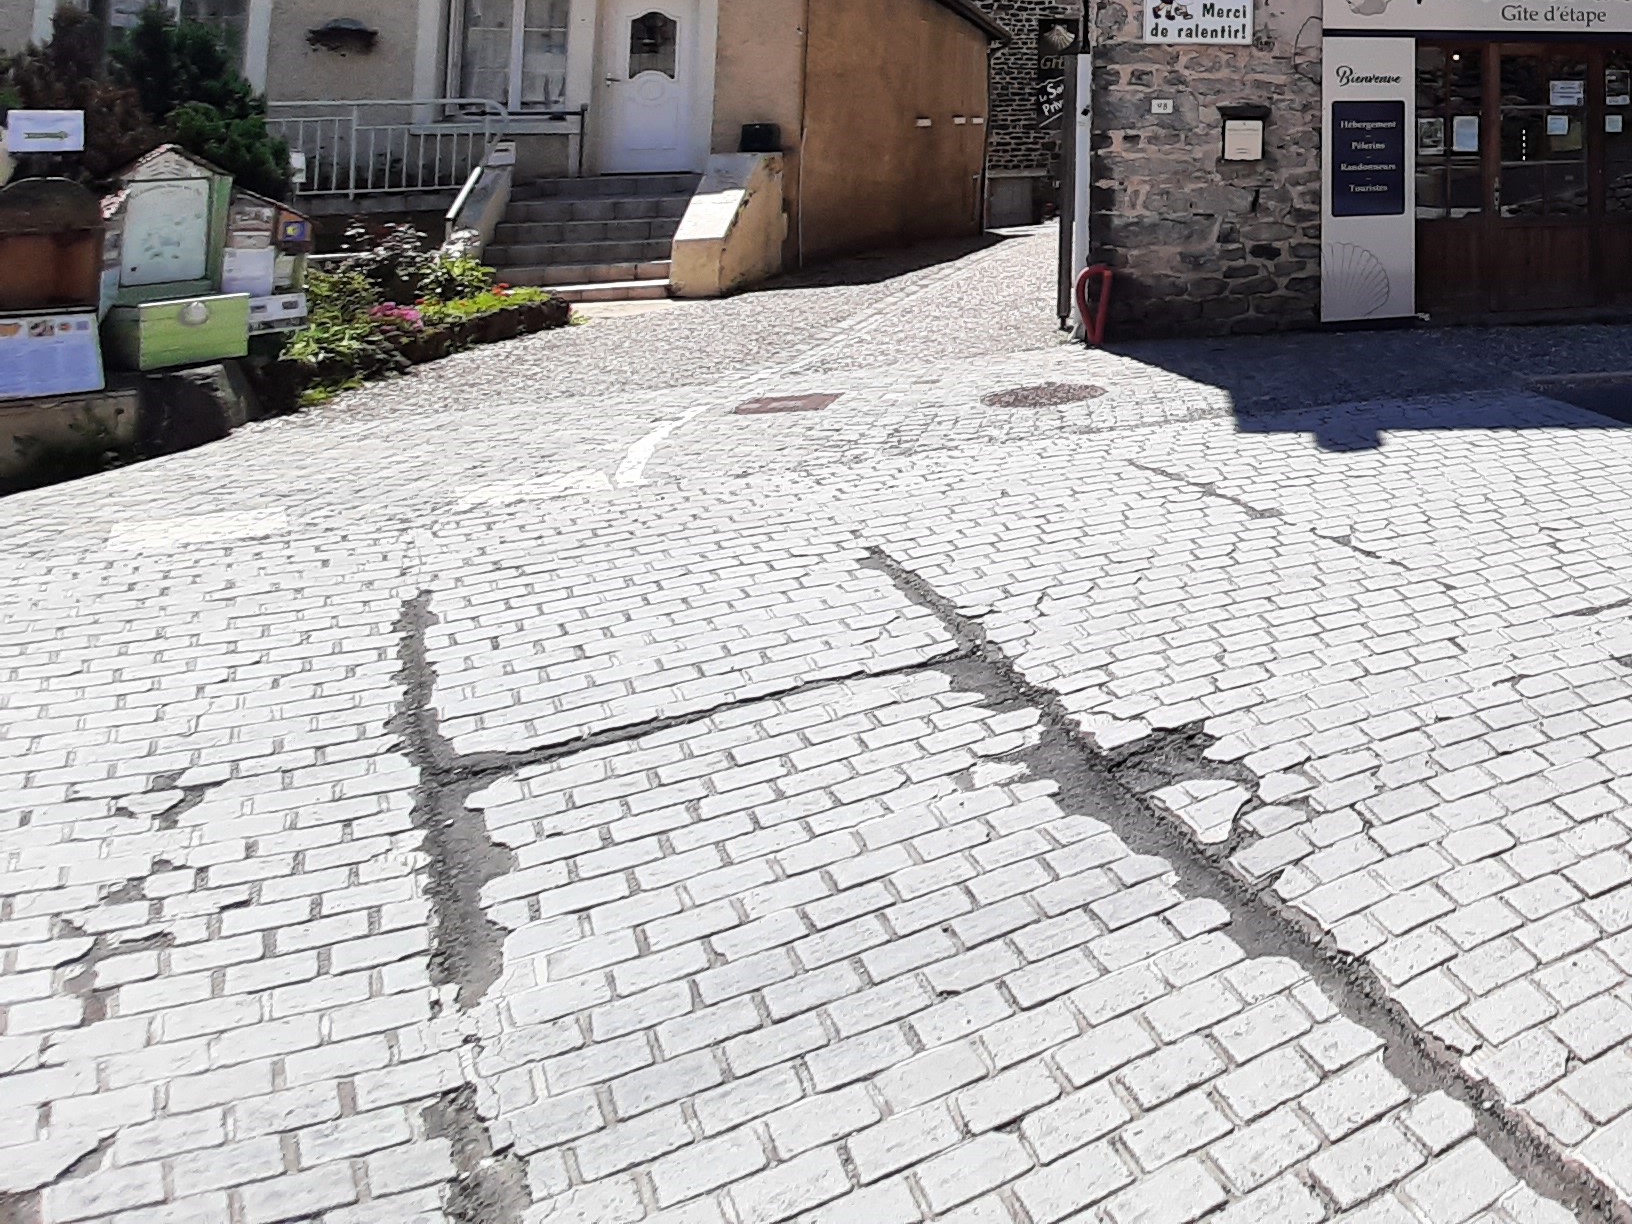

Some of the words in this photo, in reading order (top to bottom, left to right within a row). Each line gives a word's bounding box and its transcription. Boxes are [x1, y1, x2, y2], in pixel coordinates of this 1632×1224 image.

[1202, 3, 1246, 18] Merci
[1501, 5, 1539, 22] Gîte
[1544, 6, 1607, 27] d'étape
[1151, 23, 1168, 38] de
[1177, 24, 1246, 39] ralentir!
[1336, 65, 1401, 87] Bienvenue
[1042, 99, 1064, 116] Priv
[1340, 120, 1396, 129] Hébergement
[1340, 163, 1397, 171] Randonneurs
[1349, 184, 1388, 193] Touristes
